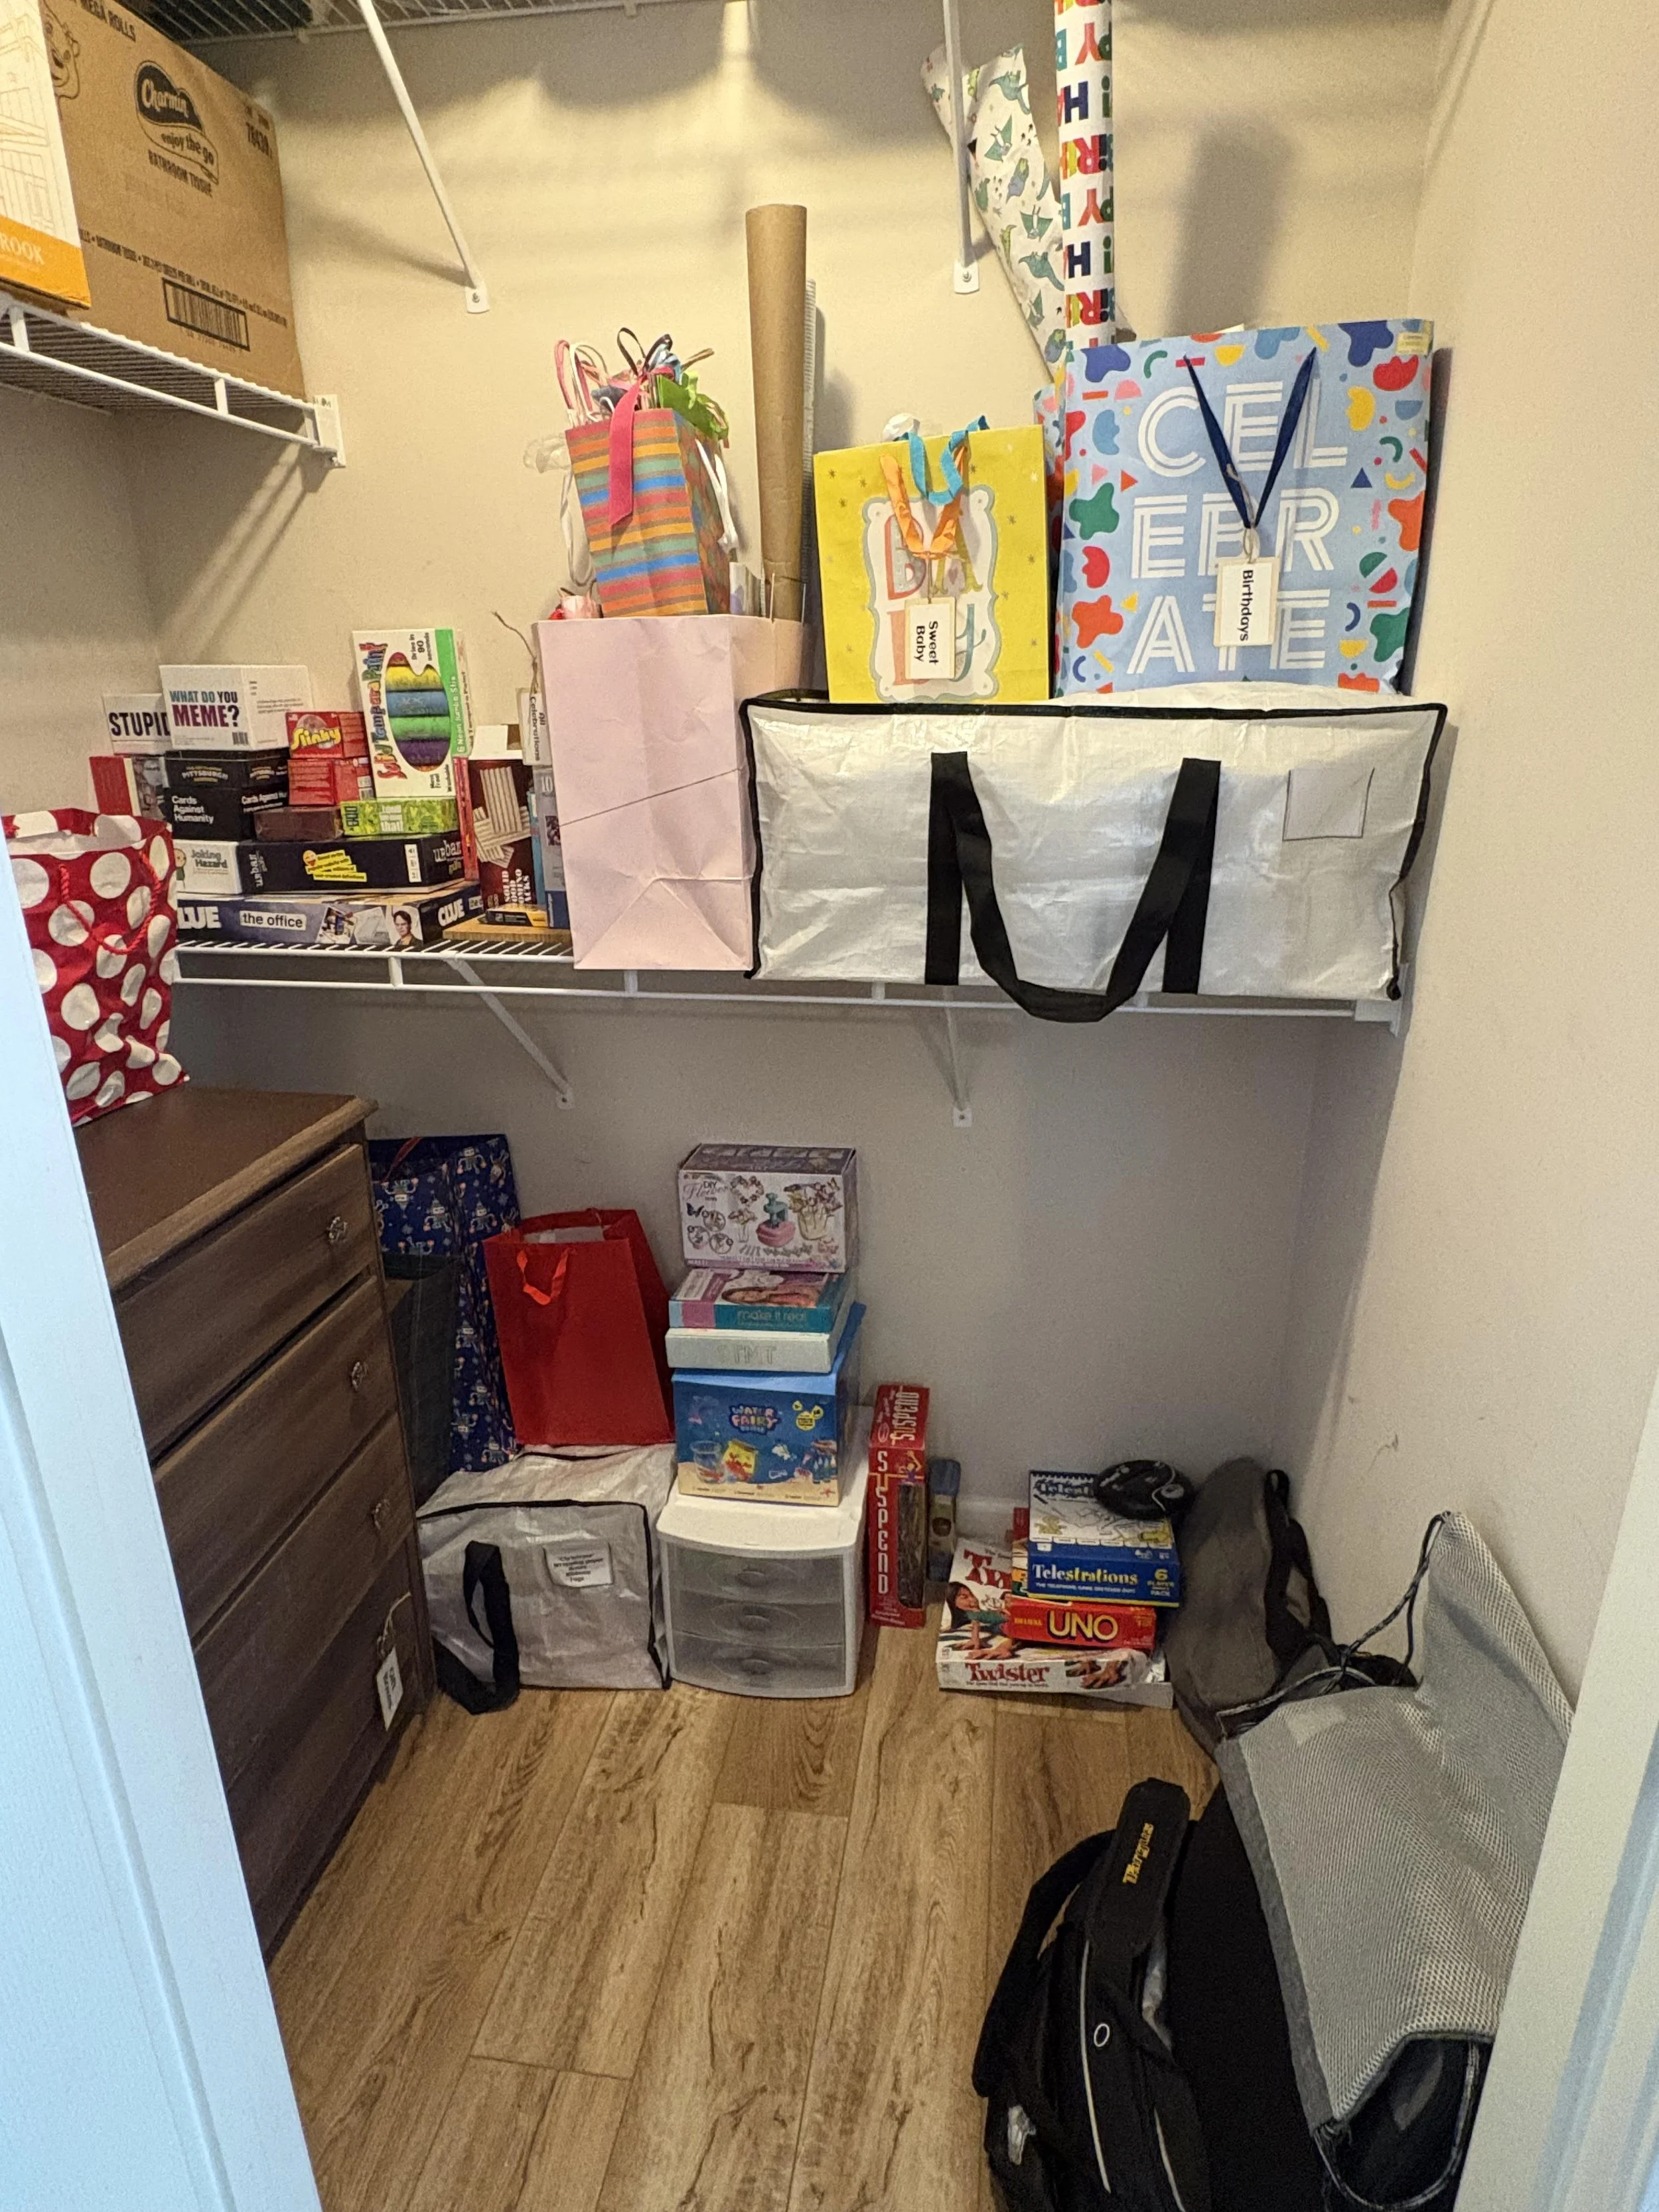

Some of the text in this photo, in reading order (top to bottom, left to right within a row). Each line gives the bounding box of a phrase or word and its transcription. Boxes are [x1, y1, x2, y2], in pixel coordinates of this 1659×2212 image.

[141, 78, 189, 118] Charmin
[161, 133, 214, 166] enjoy the go
[1240, 569, 1254, 642] Birthdays
[417, 640, 425, 654] 90
[914, 625, 925, 662] Baby
[928, 620, 939, 666] Sweet
[358, 642, 389, 680] Paint
[169, 690, 238, 703] WHAT DO YOU
[172, 704, 240, 727] MEME?
[366, 681, 390, 744] Tempera
[291, 727, 342, 751] Slinky
[456, 721, 465, 745] Neon
[530, 696, 541, 761] Celebrations
[374, 745, 408, 780] Solid
[171, 796, 198, 805] Cards
[174, 805, 204, 814] Against
[175, 814, 214, 825] Humanity
[191, 849, 222, 859] Joking
[194, 859, 228, 869] Hazard
[242, 913, 303, 928] the office
[438, 899, 465, 926] CLUE
[737, 1311, 772, 1322] make
[731, 1405, 775, 1417] WATER
[732, 1415, 778, 1430] FAIRY
[890, 1391, 920, 1445] SUSPEND
[1033, 1564, 1138, 1585] Telestrations
[1155, 1568, 1168, 1581] 6
[1048, 1610, 1118, 1641] UNO
[965, 1662, 1050, 1682] Twister
[1122, 1822, 1153, 1885] Targus
